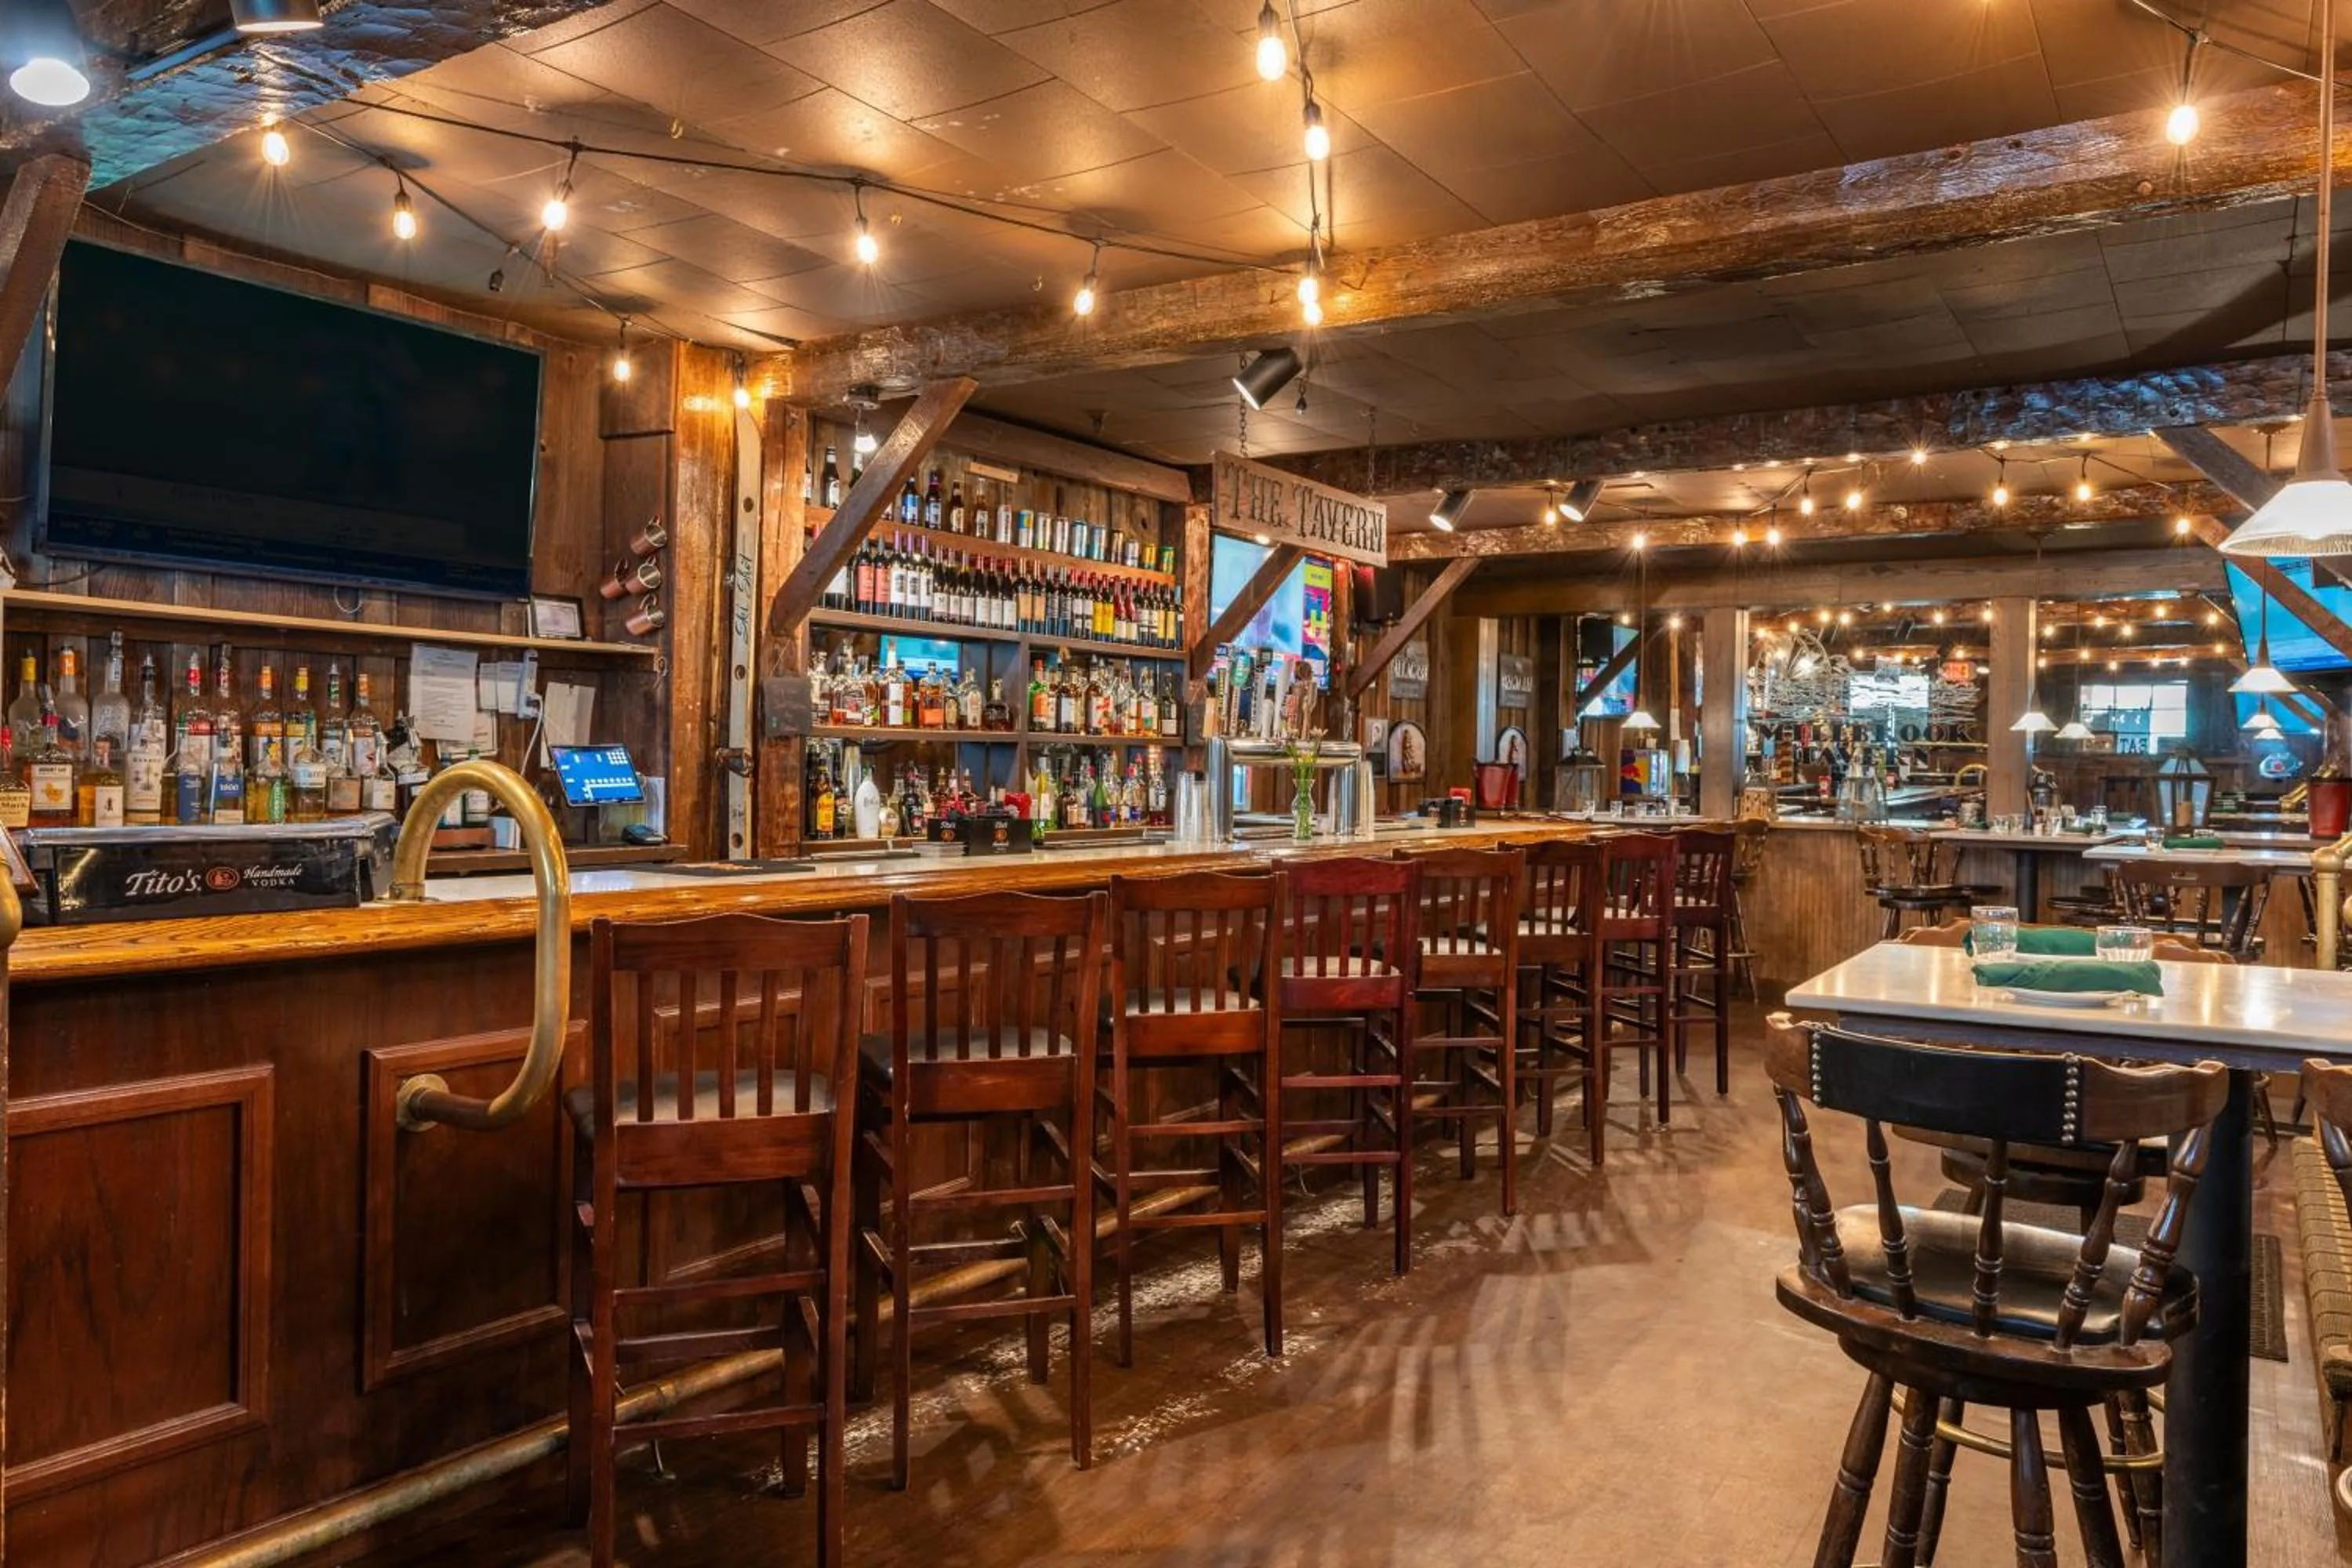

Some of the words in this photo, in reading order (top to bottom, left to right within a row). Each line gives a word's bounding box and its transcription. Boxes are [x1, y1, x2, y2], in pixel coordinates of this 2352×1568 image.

[1222, 462, 1283, 528] THE
[1291, 482, 1384, 554] TAVERN
[243, 863, 303, 880] Handmade
[251, 877, 296, 887] VODKA
[125, 869, 201, 897] Tito's
